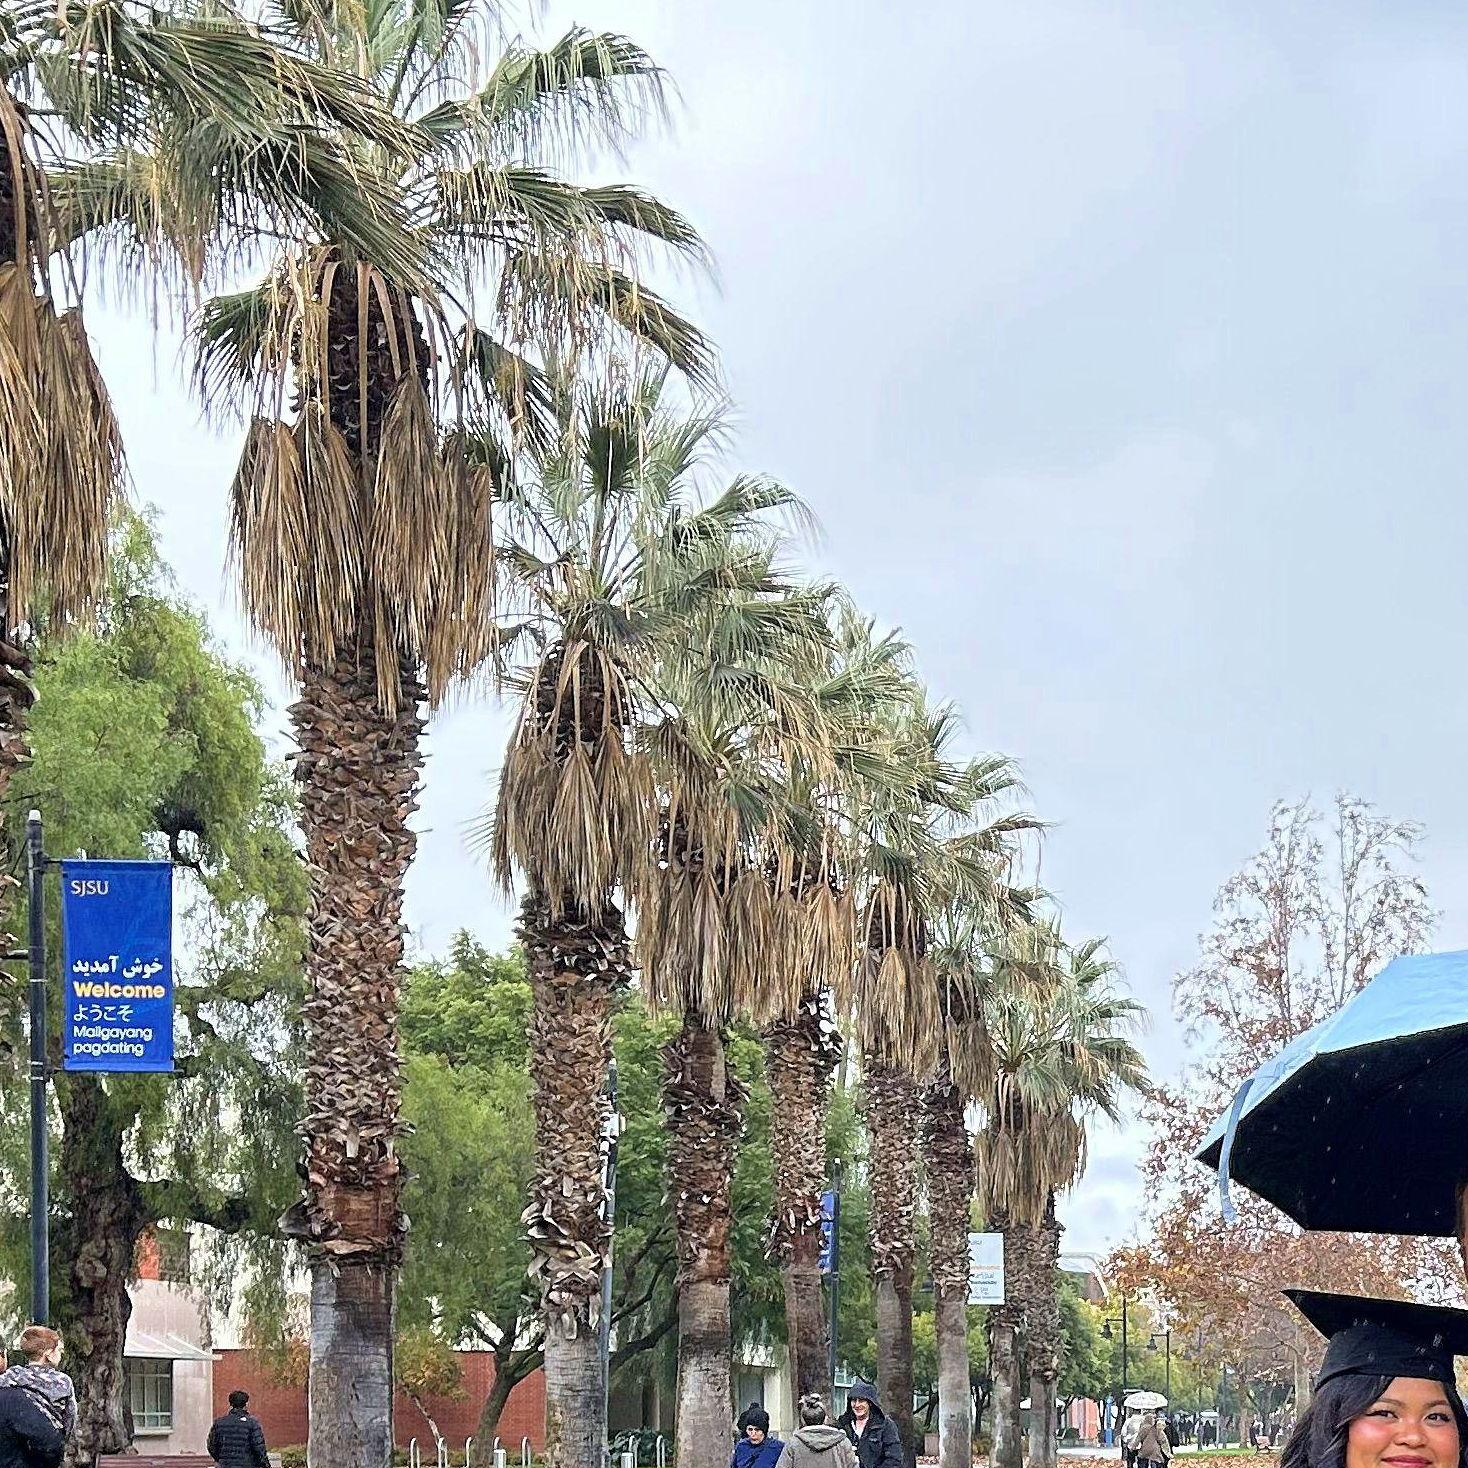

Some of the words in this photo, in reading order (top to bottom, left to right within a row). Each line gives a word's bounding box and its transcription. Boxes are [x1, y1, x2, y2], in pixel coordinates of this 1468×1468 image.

[70, 879, 109, 897] SJSU
[72, 955, 120, 977] آمدید
[122, 957, 164, 979] خوش
[72, 980, 166, 999] Welcome
[73, 1003, 134, 1022] ようこそ
[73, 1025, 153, 1042] Maligayang
[73, 1041, 144, 1057] pagdating
